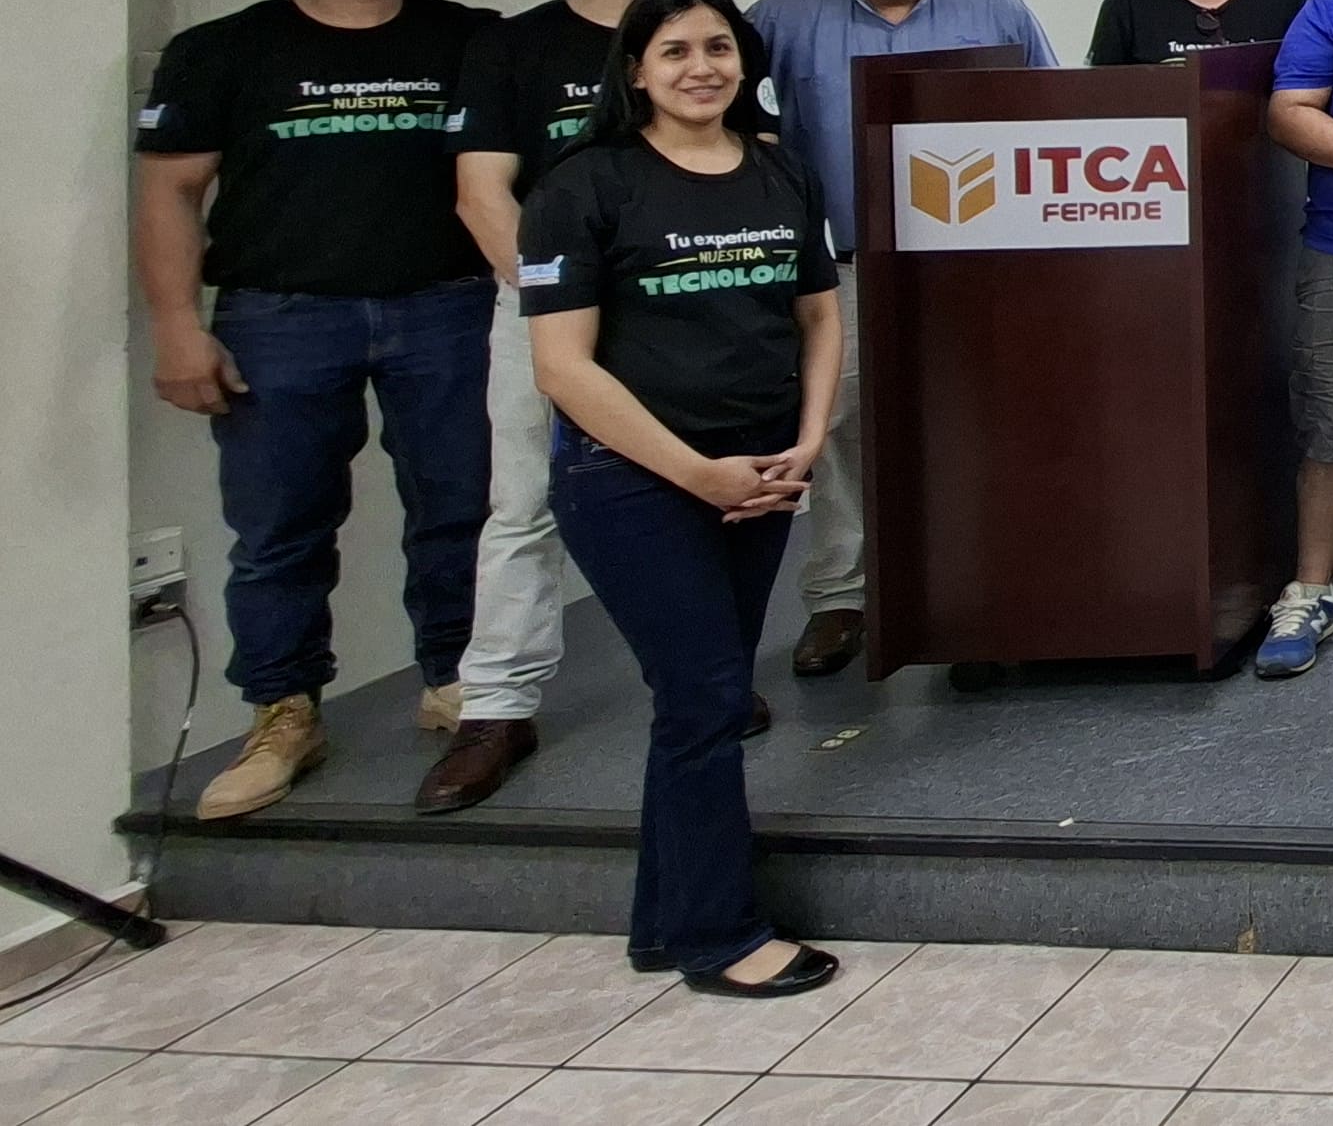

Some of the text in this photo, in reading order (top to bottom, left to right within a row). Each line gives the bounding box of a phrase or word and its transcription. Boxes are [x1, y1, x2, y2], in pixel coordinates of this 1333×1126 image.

[1168, 41, 1185, 53] Tu
[300, 78, 440, 96] Tu experiencia
[563, 82, 588, 98] Tu
[333, 96, 408, 110] NUESTRA
[269, 104, 446, 139] TECNOLOGÍ
[1014, 145, 1187, 195] ITCA
[1042, 201, 1162, 222] FEPADE
[665, 225, 795, 250] Tu experiencia
[699, 247, 765, 264] NUESTRA
